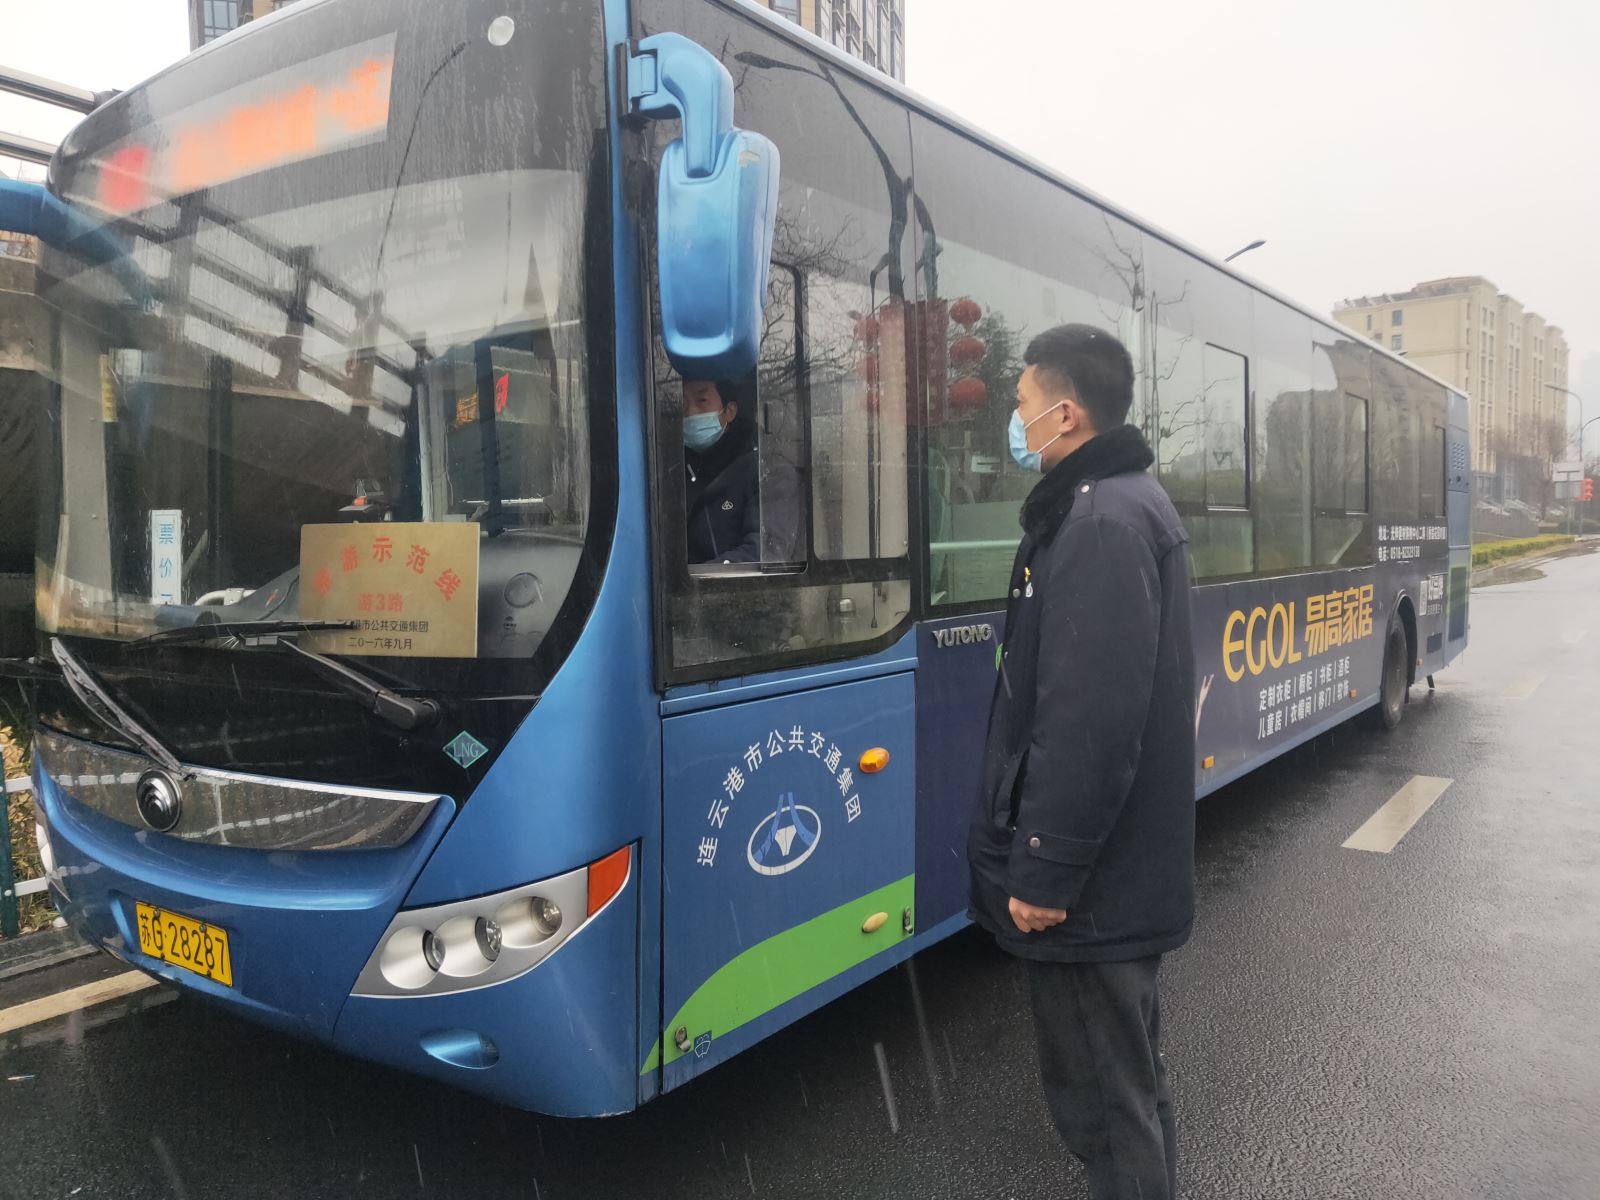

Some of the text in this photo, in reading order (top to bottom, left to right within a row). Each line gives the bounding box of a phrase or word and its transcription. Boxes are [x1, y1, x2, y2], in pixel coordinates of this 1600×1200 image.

[931, 623, 992, 649] YUTONG
[1222, 583, 1374, 683] EGOL 易高家居
[453, 742, 479, 758] LNG
[697, 725, 862, 868] 连云港市公共交通集团
